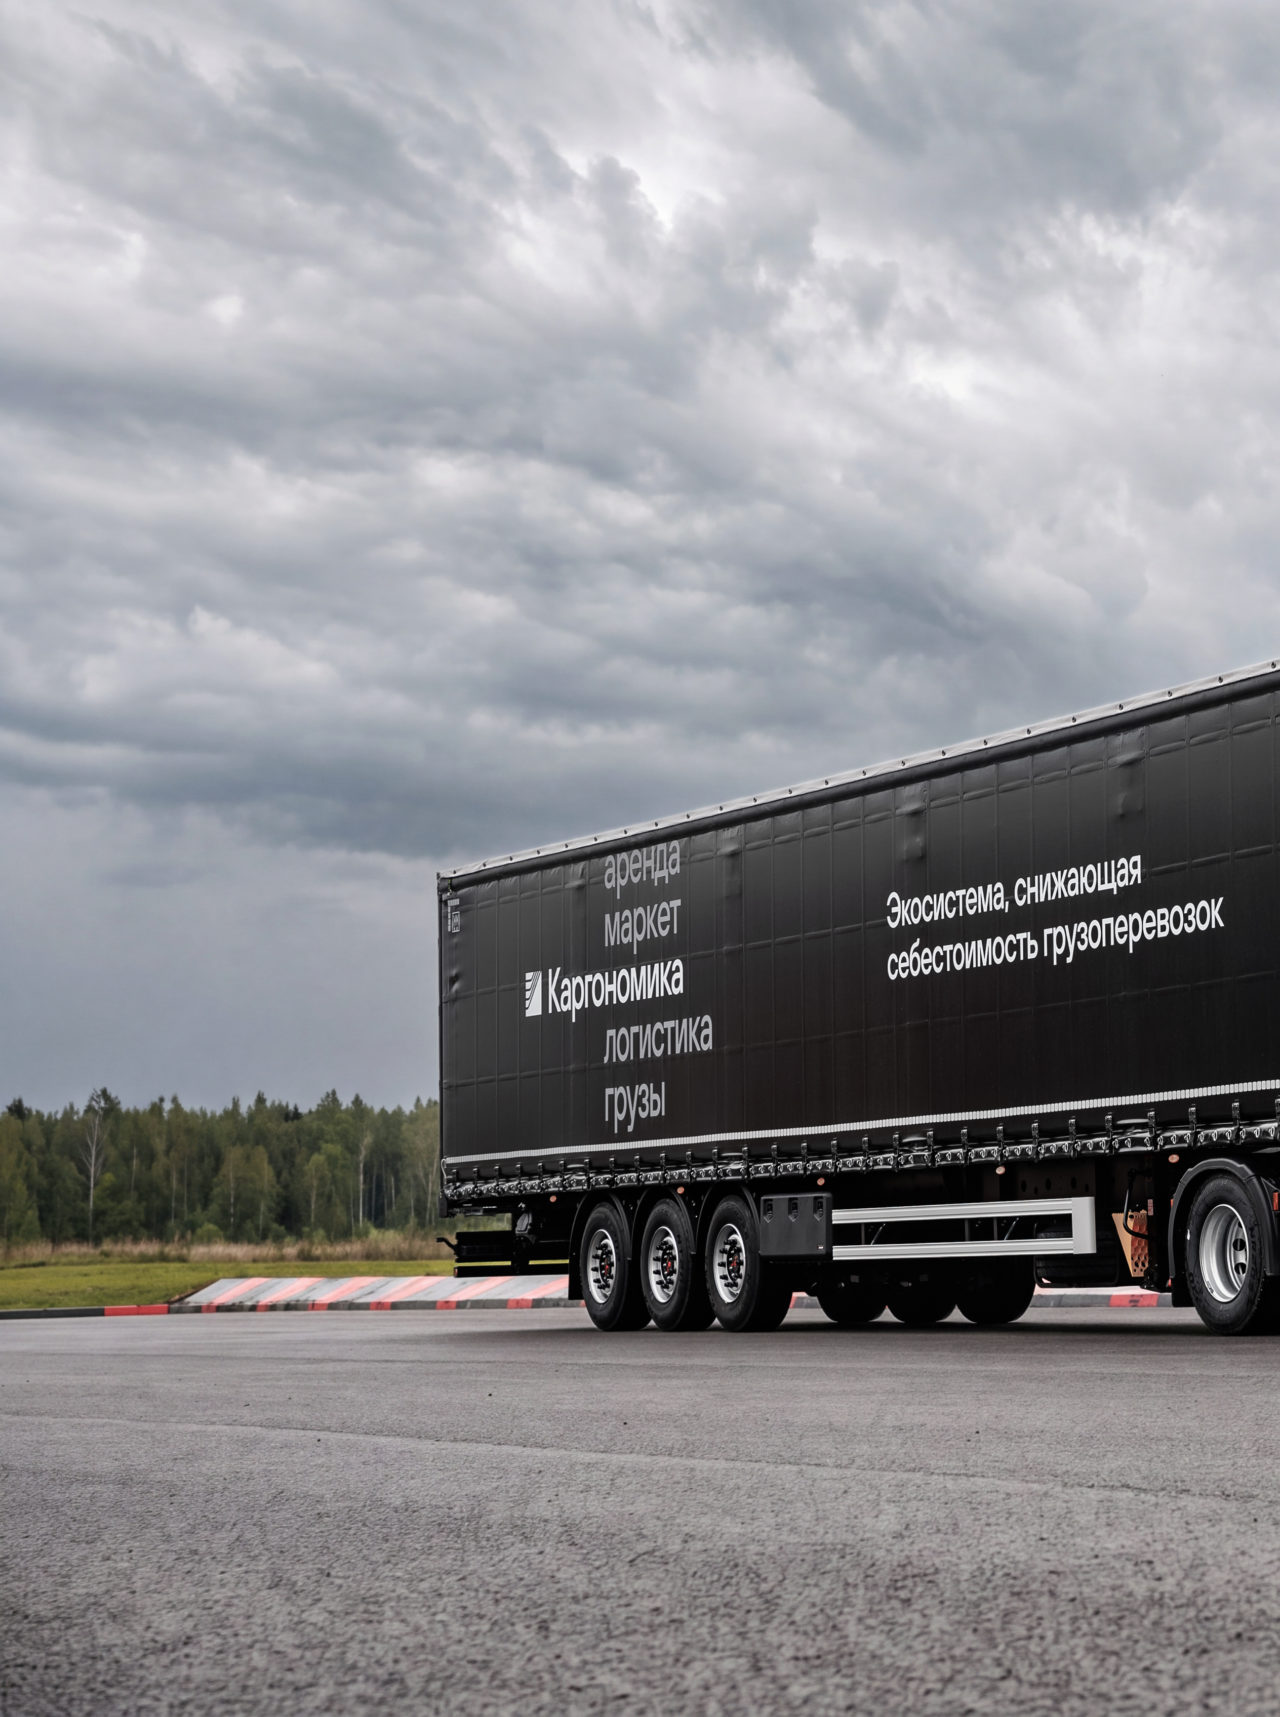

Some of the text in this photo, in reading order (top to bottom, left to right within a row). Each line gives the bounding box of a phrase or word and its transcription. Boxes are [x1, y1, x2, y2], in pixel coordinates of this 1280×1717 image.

[604, 839, 681, 899] аренда
[886, 854, 1142, 928] Экосистема, снижающая
[604, 898, 682, 954] маркет
[887, 897, 1225, 980] себестоимость грузоперевозок
[548, 958, 684, 1022] Каргономика
[603, 1014, 713, 1064] логистика
[604, 1081, 666, 1133] грузы
